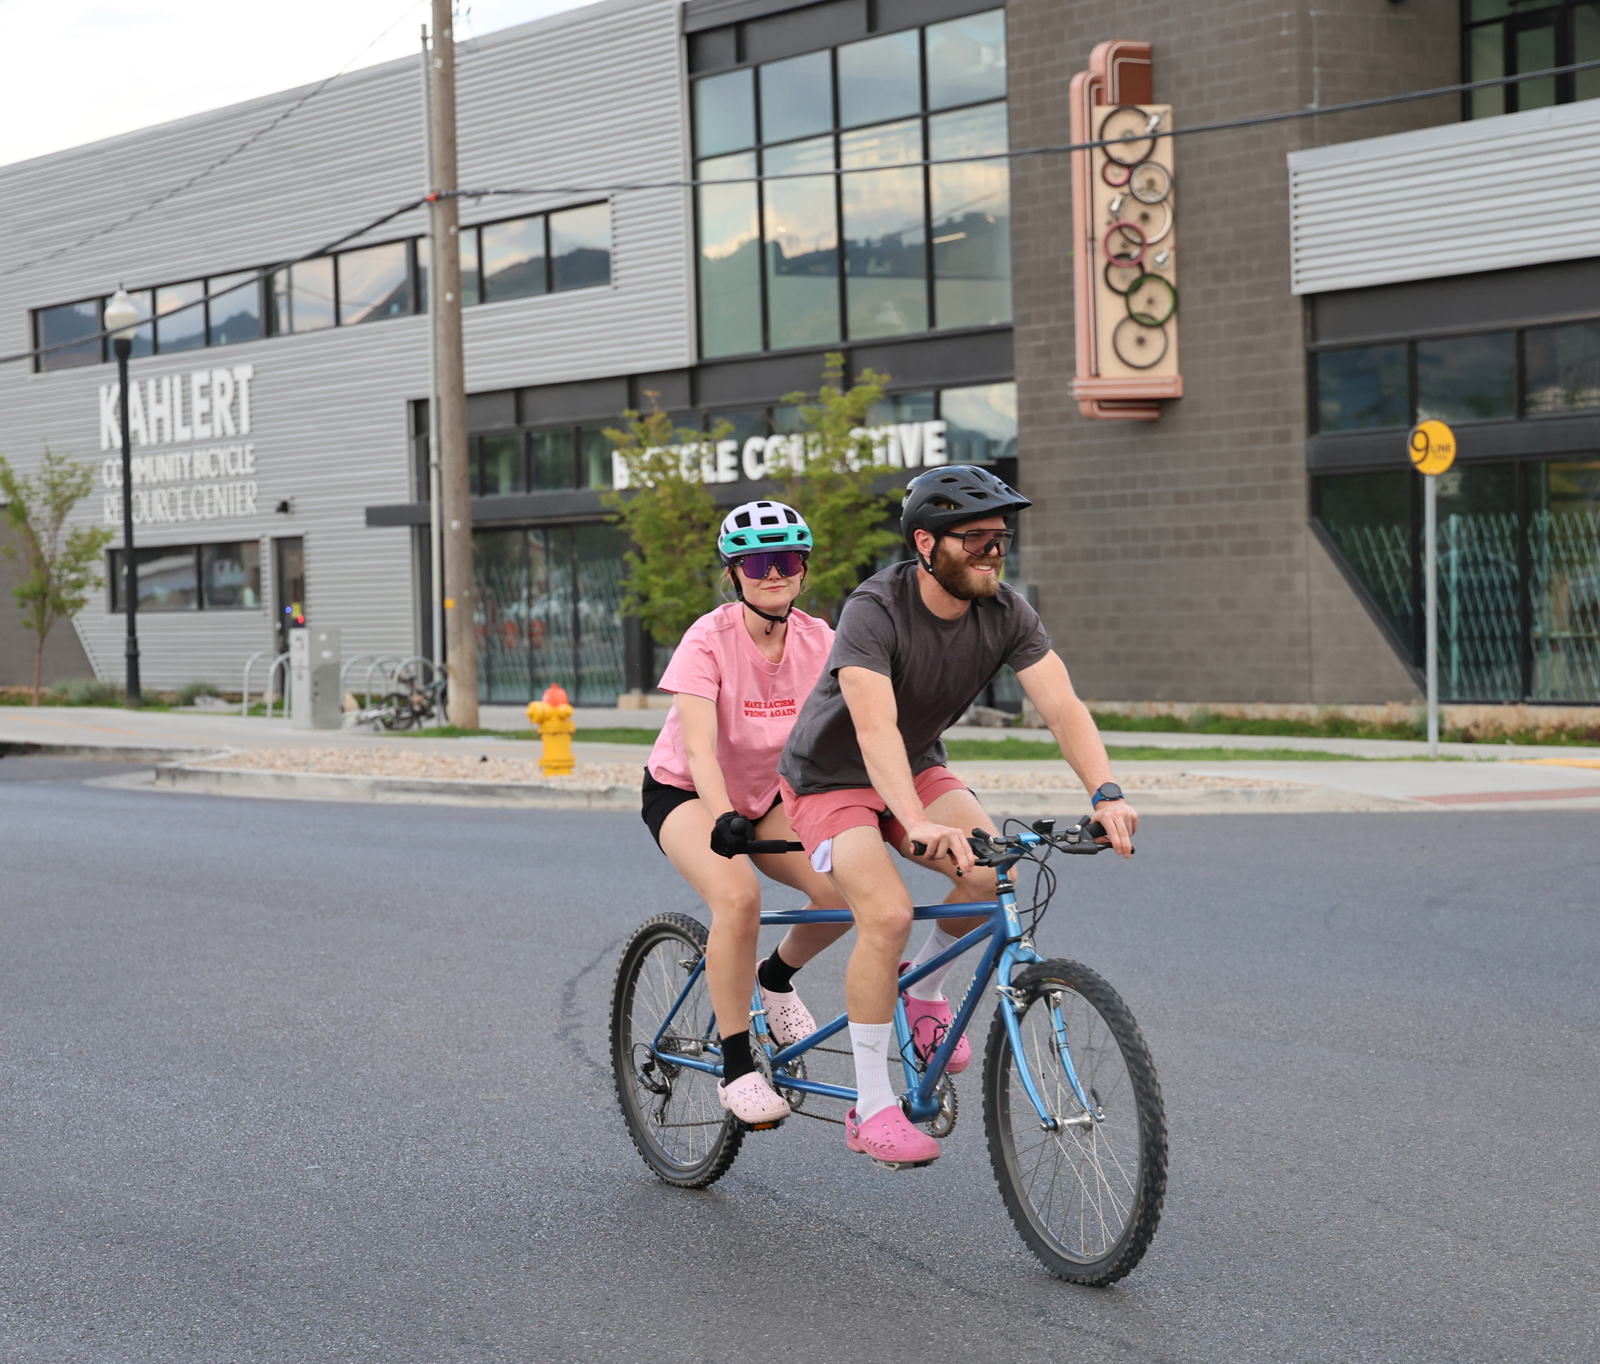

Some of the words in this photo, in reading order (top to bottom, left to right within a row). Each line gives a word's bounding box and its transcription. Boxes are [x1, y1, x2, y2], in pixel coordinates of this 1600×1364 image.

[99, 364, 253, 450] KAHLERT
[102, 451, 192, 487] COMUNITY
[193, 443, 256, 479] BICYCLE
[1411, 430, 1429, 464] 9
[103, 486, 189, 526] REOURCE
[190, 479, 258, 520] CENTER
[744, 700, 762, 709] MAKE
[764, 699, 795, 709] RACISM
[744, 710, 767, 718] WRONG
[770, 708, 796, 718] AGAIN
